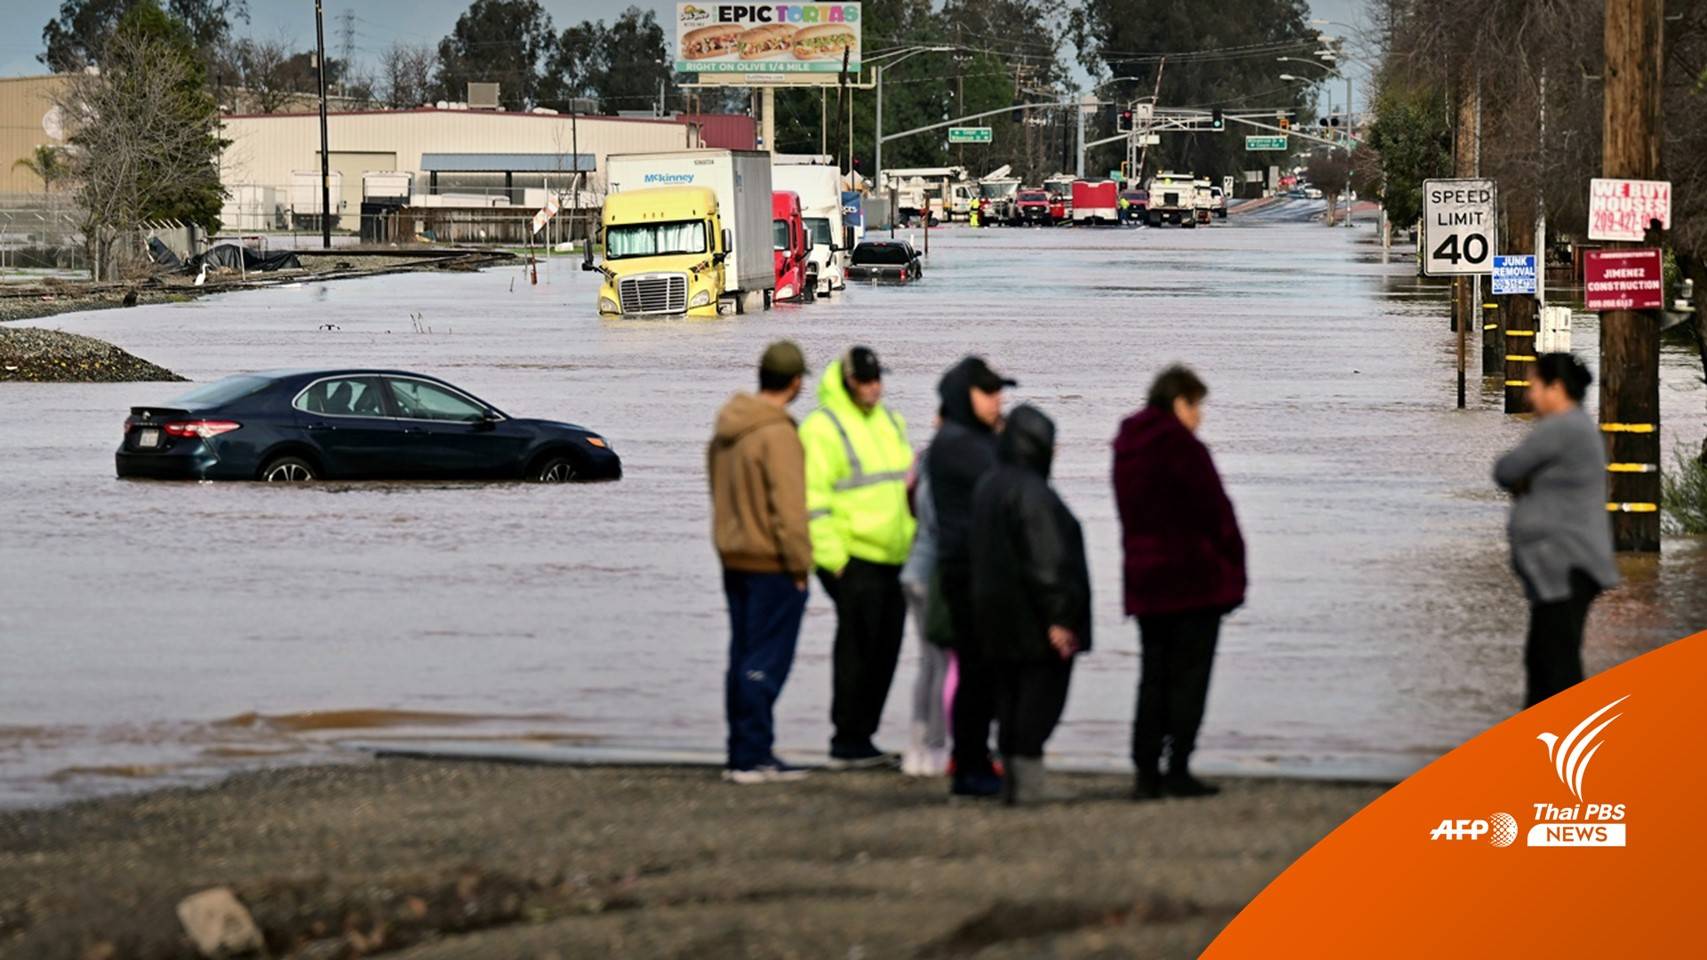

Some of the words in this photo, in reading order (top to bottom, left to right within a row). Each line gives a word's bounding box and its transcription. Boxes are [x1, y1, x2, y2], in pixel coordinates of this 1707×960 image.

[718, 5, 772, 23] EPIC
[775, 5, 858, 23] TORTAS
[686, 63, 717, 72] RIGHT
[719, 63, 735, 72] ON
[737, 63, 766, 72] OLIVE
[769, 63, 784, 72] 1/4
[786, 63, 810, 72] MILE
[1431, 190, 1491, 204] SPEED
[1593, 182, 1624, 197] WE
[1630, 183, 1667, 199] BUY
[1593, 197, 1667, 213] HOUSES
[1438, 212, 1484, 226] LIMIT
[1432, 233, 1489, 265] 40
[1502, 256, 1527, 267] JUNK
[1494, 266, 1535, 277] REMOVAL
[1602, 268, 1645, 279] JIMENEZ
[1587, 280, 1660, 292] CONSTRUCTION
